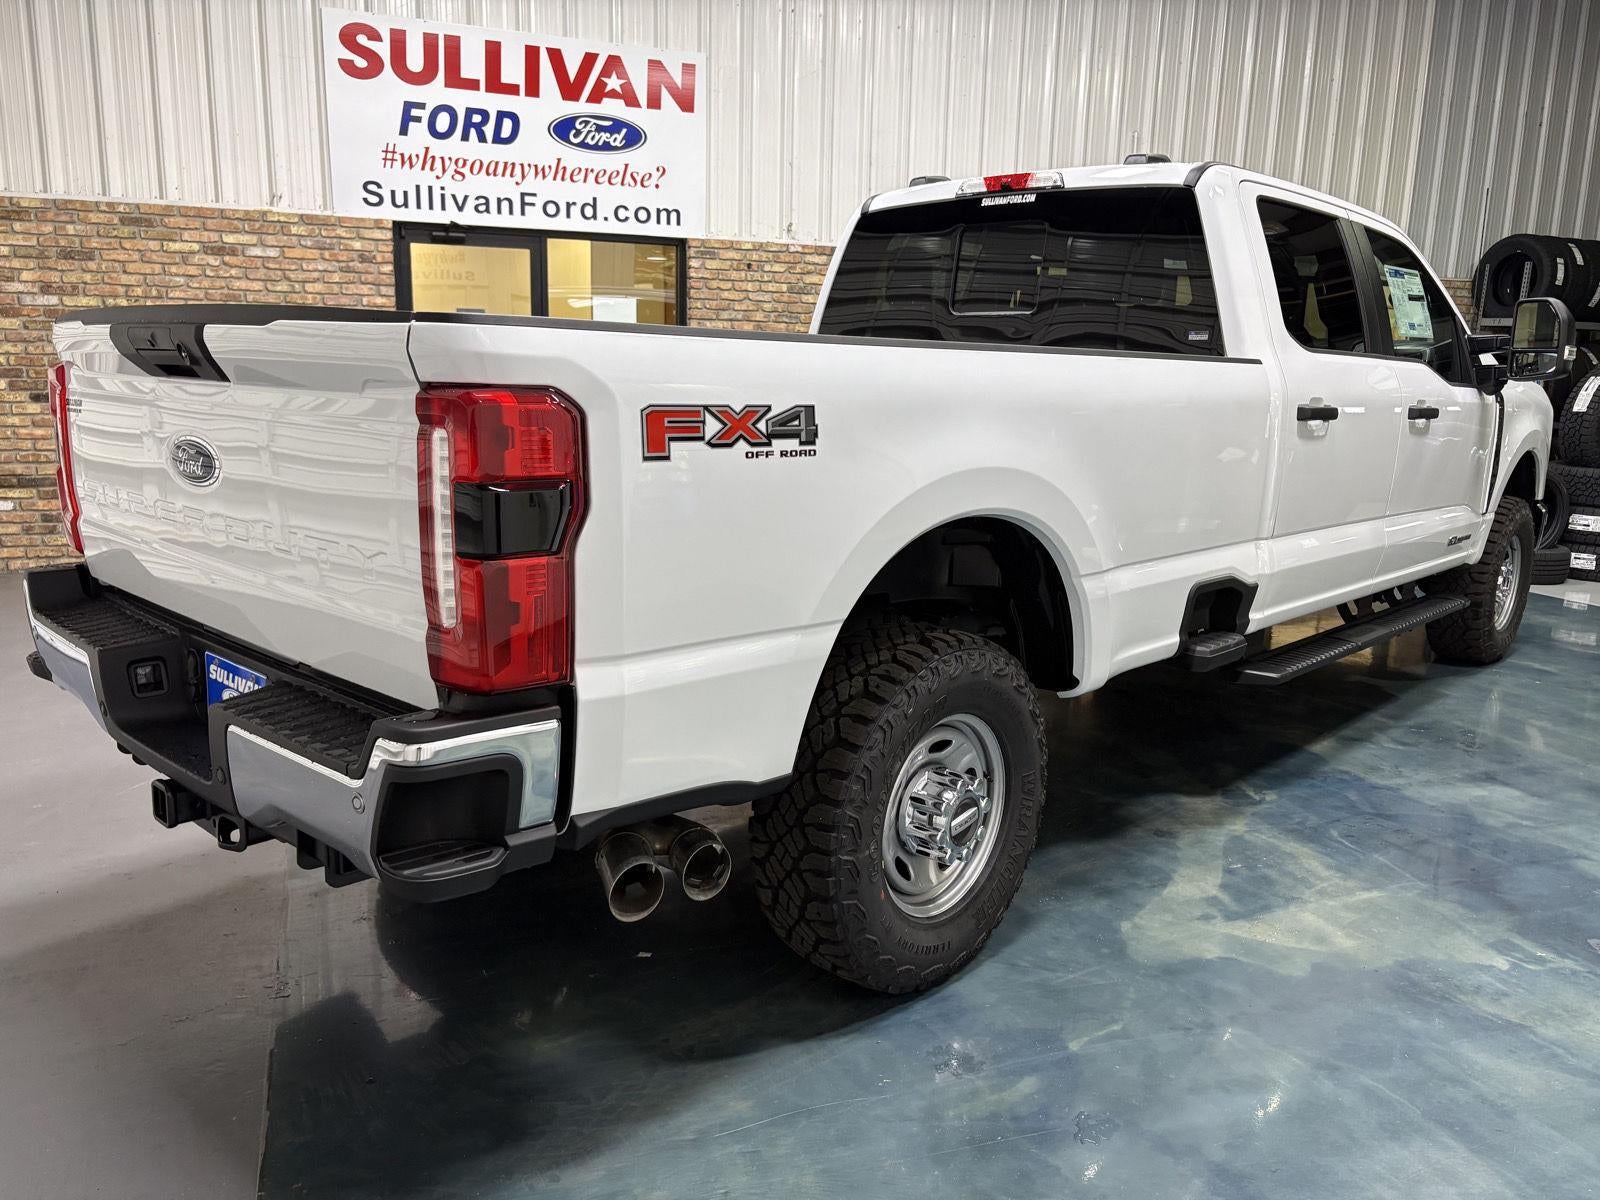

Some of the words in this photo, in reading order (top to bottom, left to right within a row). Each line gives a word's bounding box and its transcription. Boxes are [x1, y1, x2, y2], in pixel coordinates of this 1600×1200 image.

[337, 22, 696, 113] SULLIVAN
[398, 100, 521, 146] FORD
[566, 114, 630, 150] Ford
[381, 142, 667, 189] #whygoanywhereelse?
[362, 180, 682, 226] SullivanFord.com
[981, 194, 1036, 207] SULLIVANFORD.COM
[641, 404, 818, 461] FX4
[745, 451, 774, 459] OFF
[779, 449, 817, 458] ROAD
[175, 445, 206, 478] Ford
